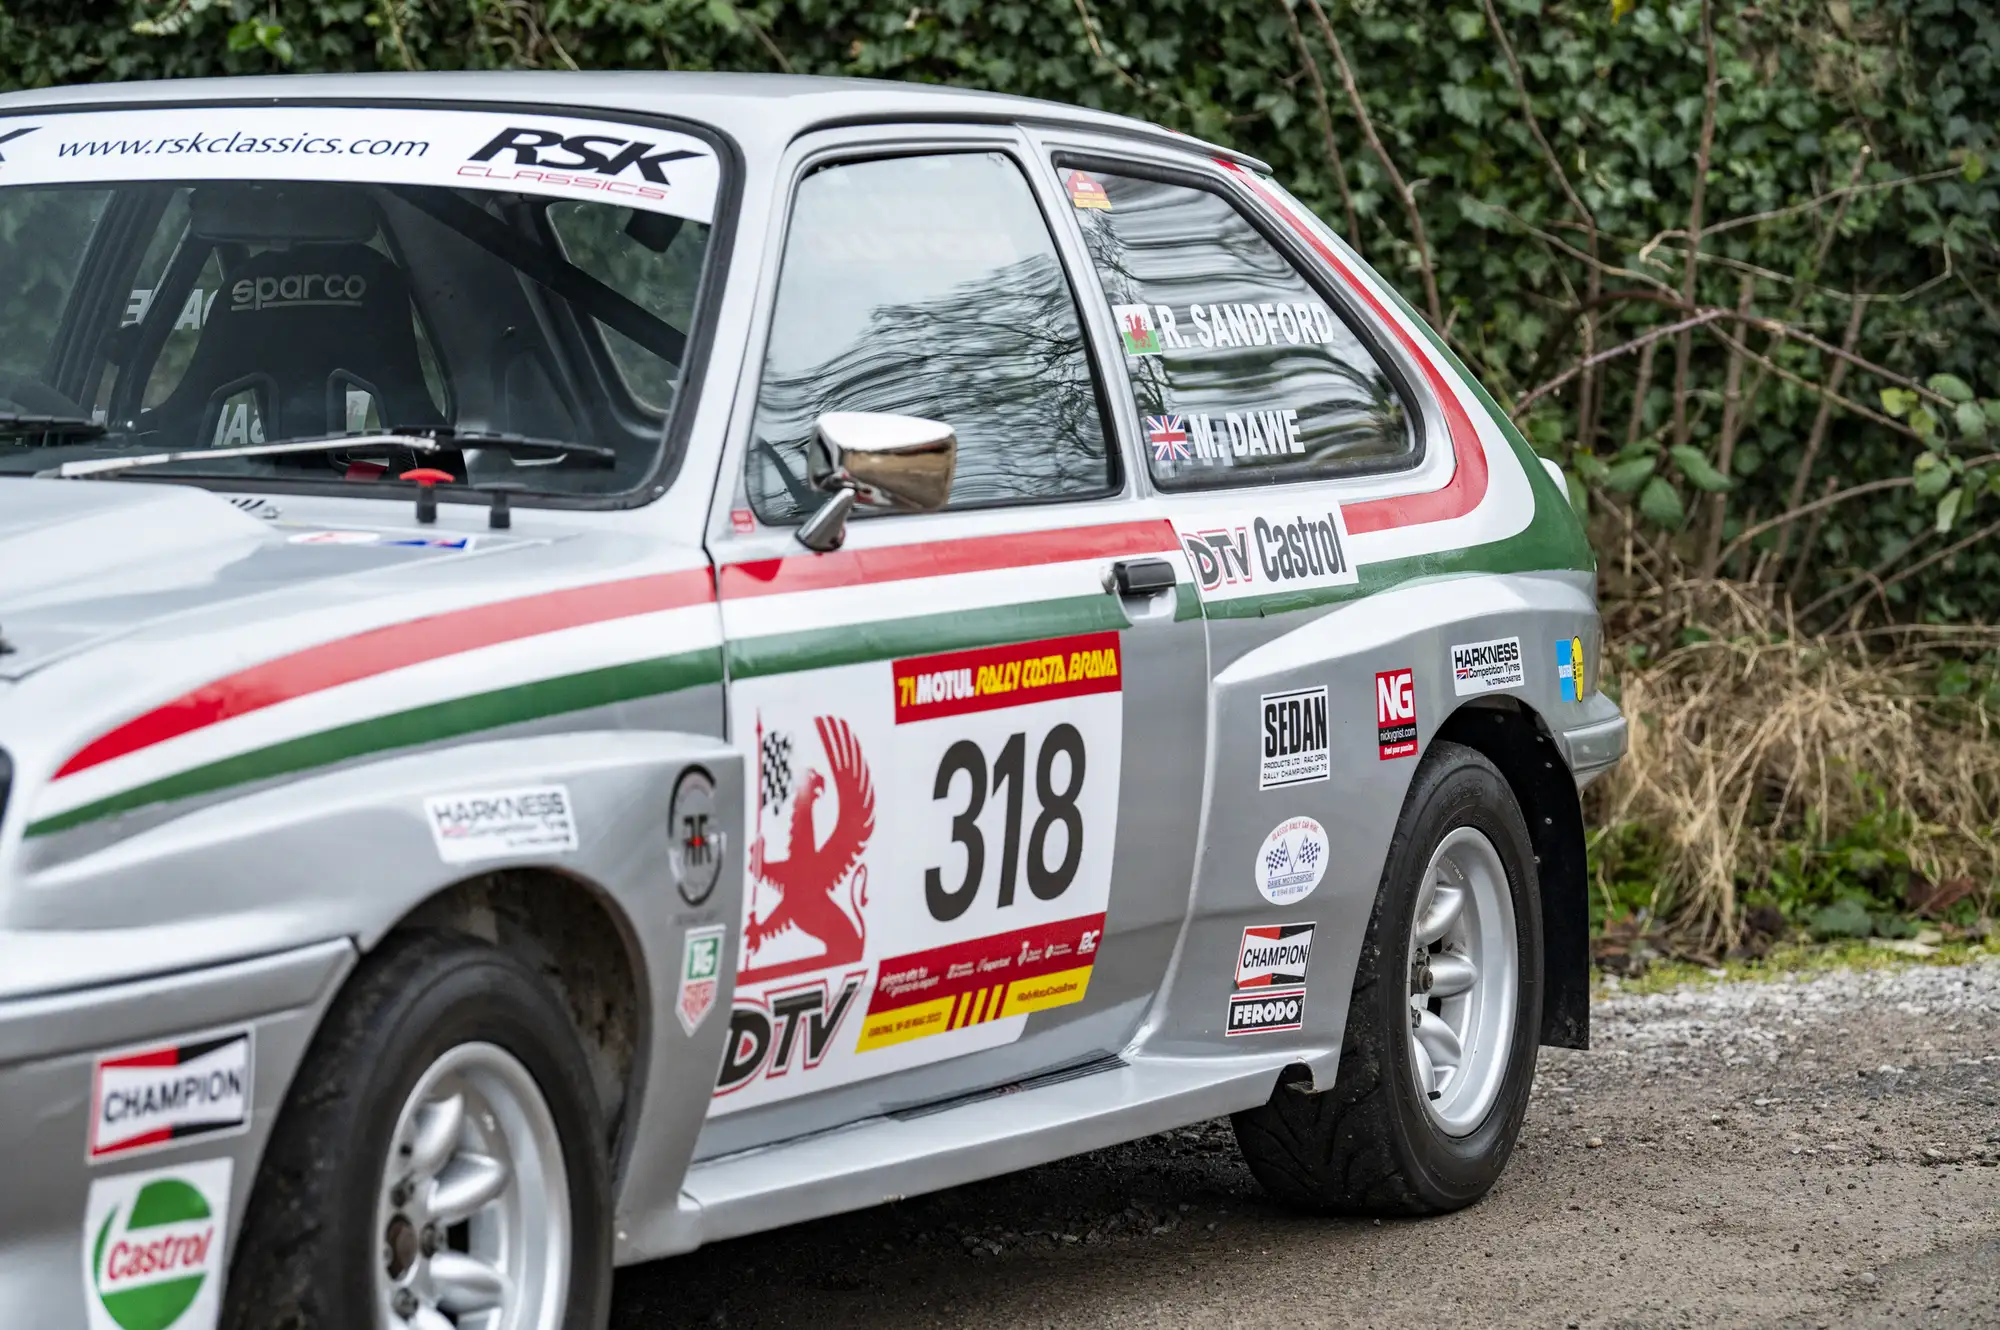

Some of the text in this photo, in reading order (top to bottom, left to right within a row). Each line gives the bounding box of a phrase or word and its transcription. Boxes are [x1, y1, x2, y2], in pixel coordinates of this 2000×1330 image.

[58, 132, 430, 157] www.rskclassics.com
[467, 127, 709, 185] RSK
[457, 166, 668, 200] CLASSICS
[231, 273, 367, 310] sparco
[1155, 302, 1334, 348] R. SANDFORD
[1188, 409, 1306, 459] M. DAWE
[1182, 512, 1347, 591] DTV Castrol
[916, 668, 974, 704] MOTUL
[975, 661, 1022, 696] RALLY
[1022, 655, 1067, 688] COSTA
[1068, 648, 1119, 682] BRAVA
[1454, 642, 1519, 669] HARKNESS
[1468, 662, 1521, 679] Competition Tyres
[1377, 673, 1415, 722] NG
[1265, 695, 1328, 758] SEDAN
[1379, 727, 1416, 742] nickygrist.com
[1263, 772, 1280, 780] RALLY
[1280, 764, 1319, 778] CHAMPIONSHIP
[1264, 759, 1290, 770] PRODUCTS
[1291, 757, 1300, 766] LTD
[1314, 753, 1328, 762] OPEN
[433, 792, 565, 822] HARKNESS
[924, 723, 1086, 922] 318
[1243, 944, 1309, 968] CHAMPION
[1233, 1000, 1299, 1026] FERODO
[714, 974, 865, 1094] DTV
[103, 1070, 242, 1123] CHAMPION
[108, 1226, 214, 1281] Castrol
